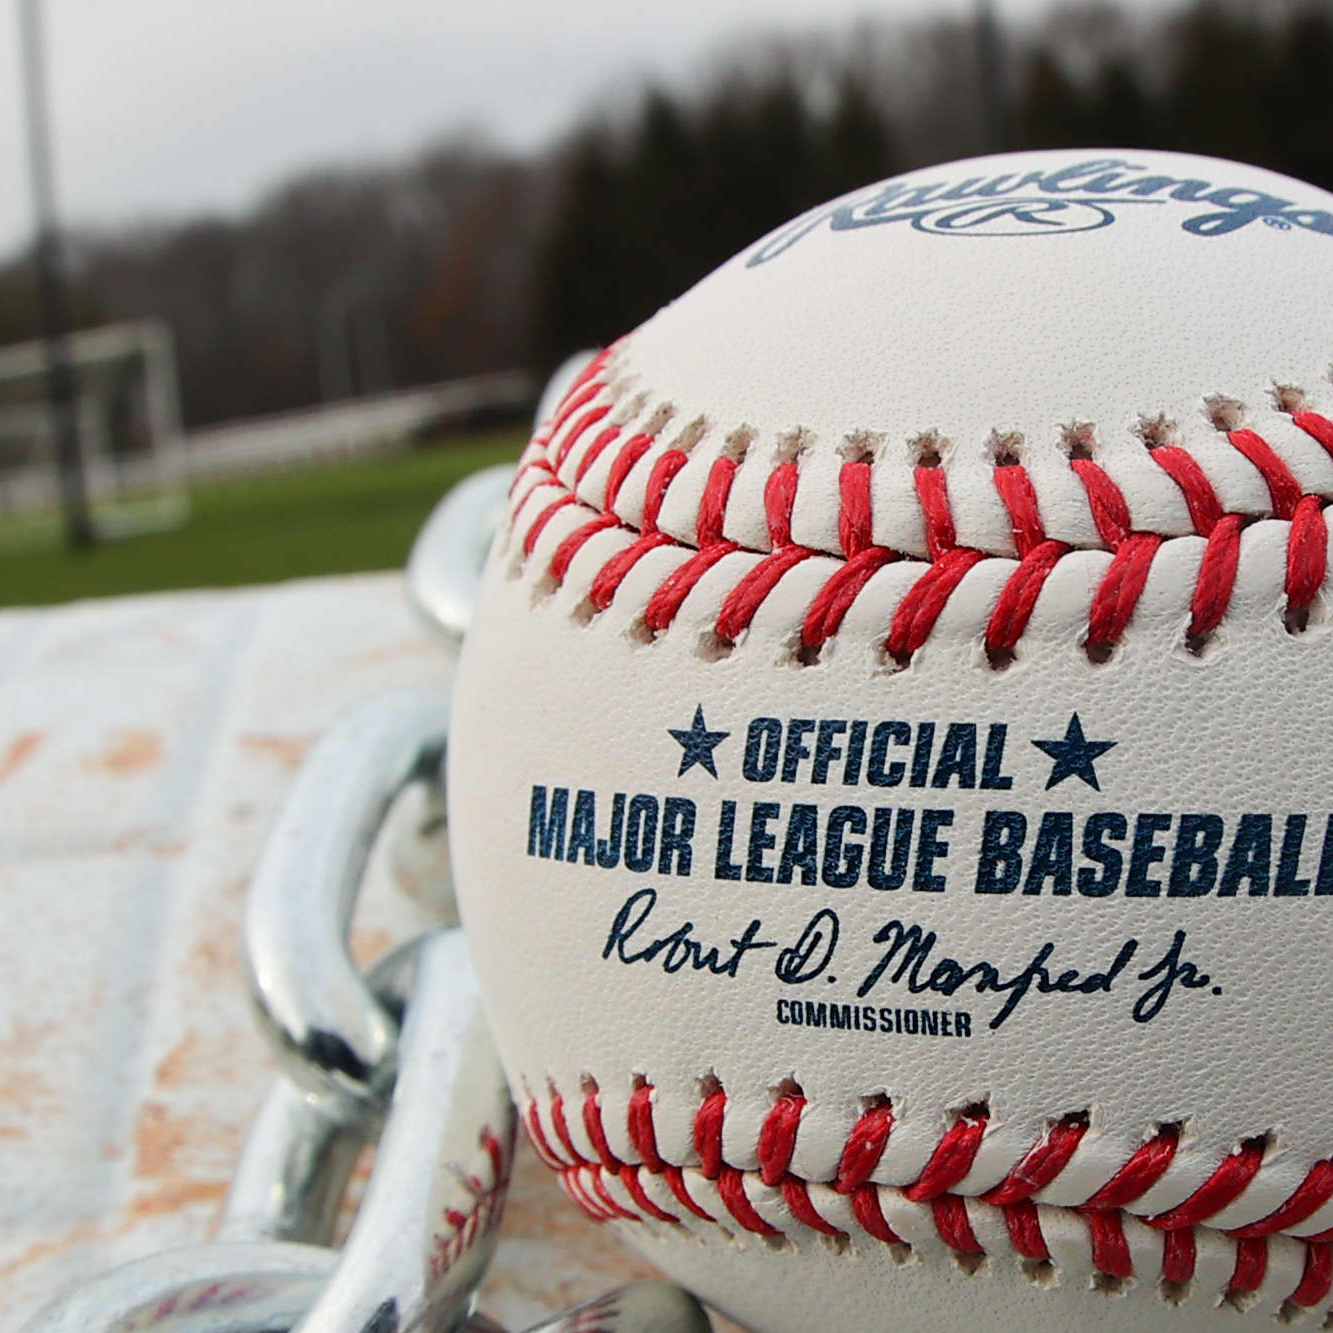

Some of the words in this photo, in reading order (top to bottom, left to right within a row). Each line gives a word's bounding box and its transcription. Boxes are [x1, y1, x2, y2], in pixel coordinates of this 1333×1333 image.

[742, 716, 1012, 790] OFFICIAL
[526, 784, 697, 877] MAJOR
[713, 800, 955, 893] LEAGUE
[775, 998, 972, 1038] COMMISSIONER
[856, 918, 1139, 1029] Manfred
[1138, 929, 1223, 1024] Jr.
